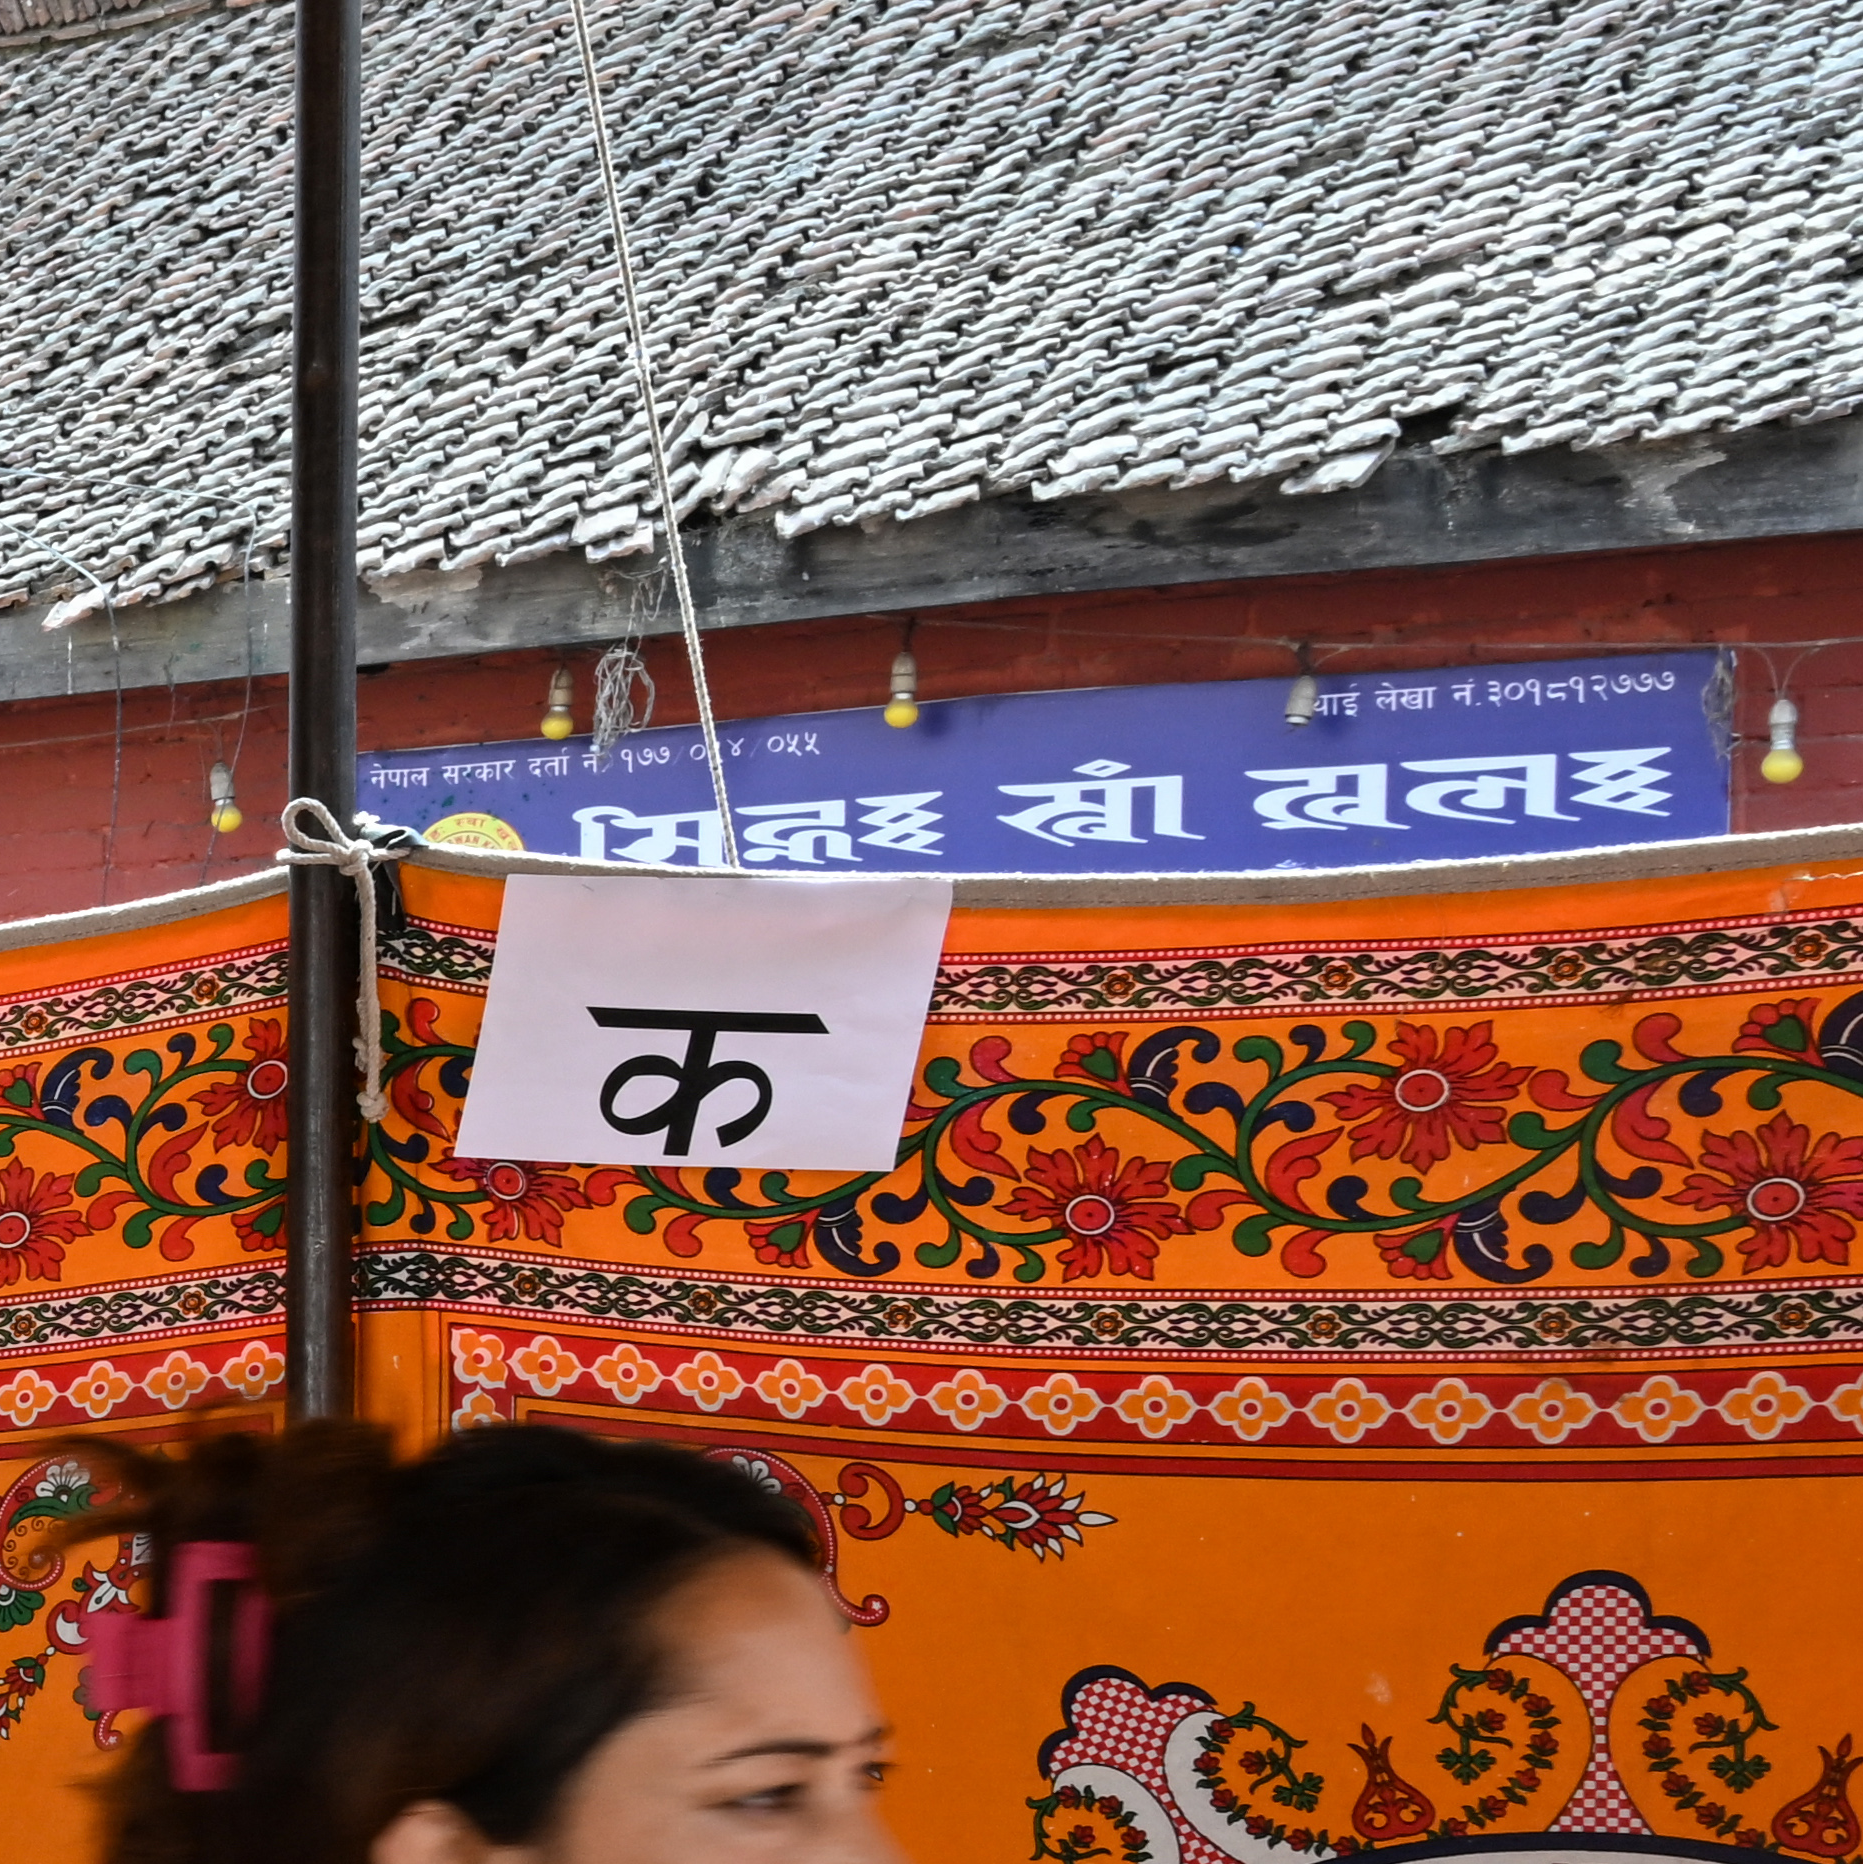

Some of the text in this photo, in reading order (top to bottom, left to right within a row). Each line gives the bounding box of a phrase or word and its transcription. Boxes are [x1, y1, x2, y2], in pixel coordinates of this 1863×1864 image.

[1374, 682, 1437, 711] लेखा
[370, 763, 430, 789] नेपाल
[441, 759, 516, 785] सरकार
[528, 747, 570, 777] दर्ता
[620, 732, 821, 773] १७७/०४/०५५
[585, 1006, 830, 1157] क
